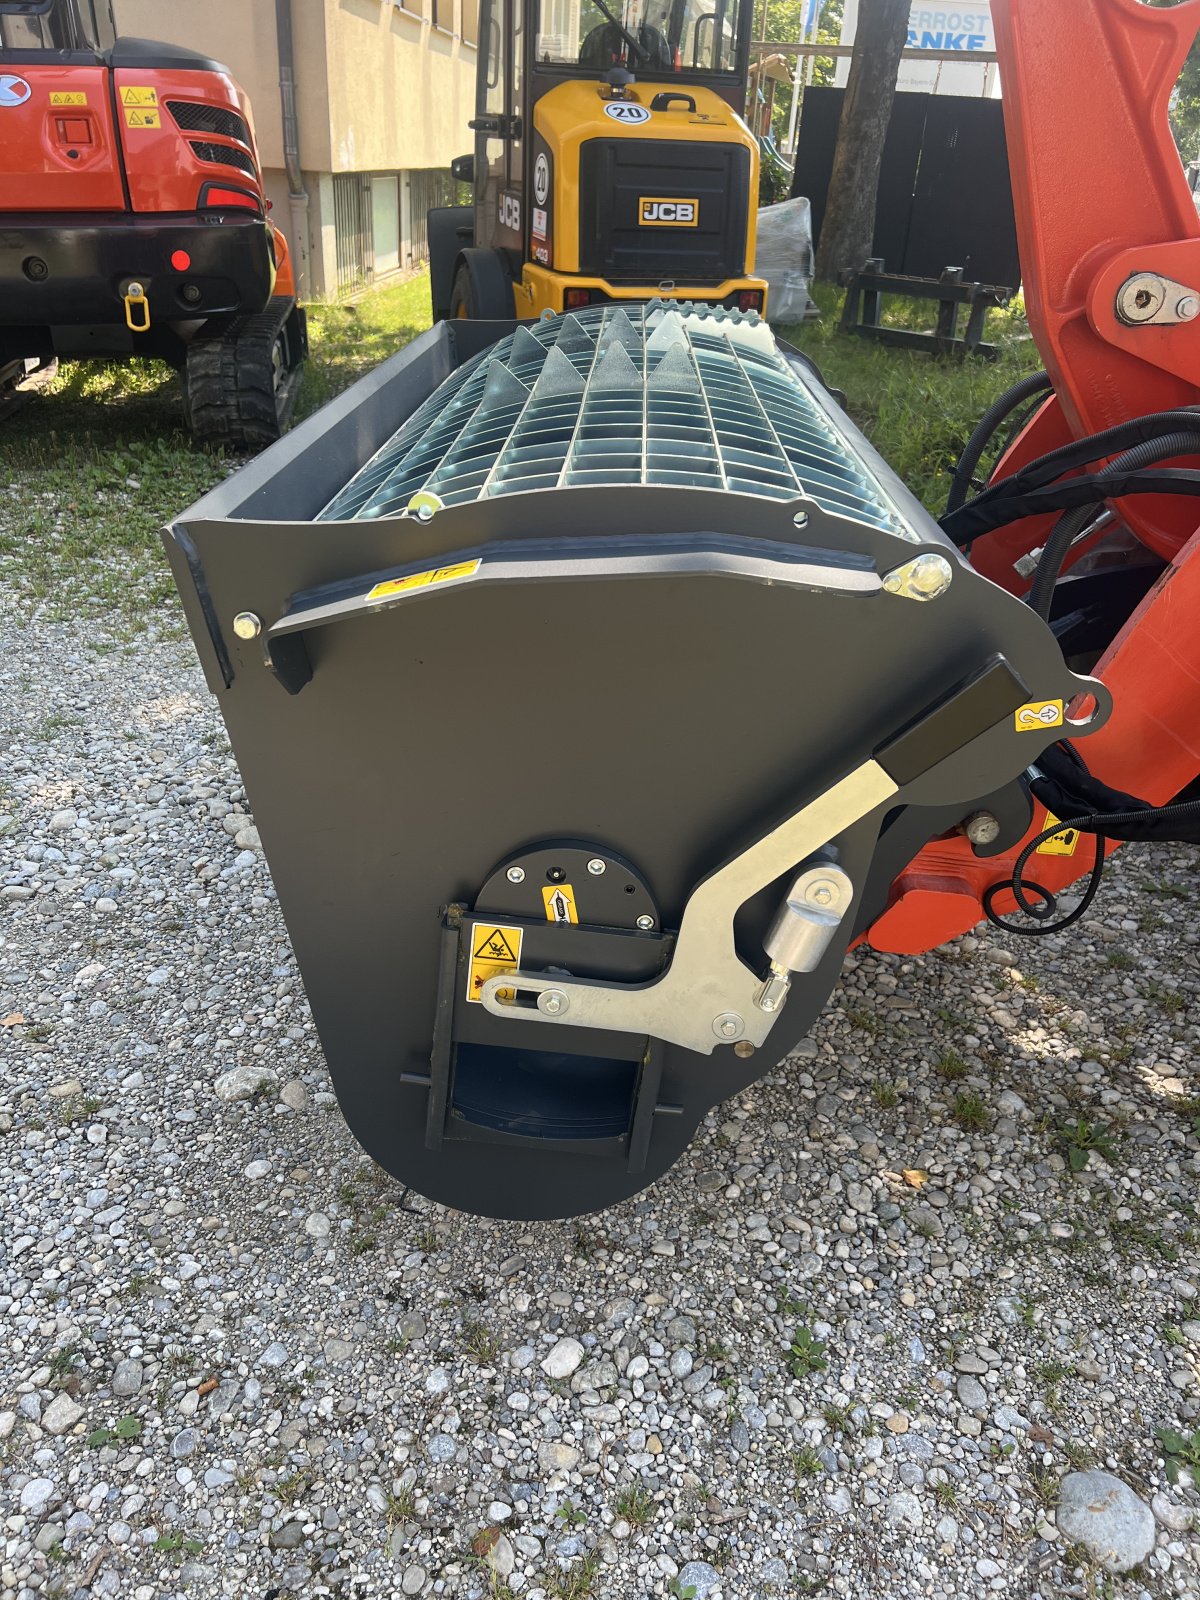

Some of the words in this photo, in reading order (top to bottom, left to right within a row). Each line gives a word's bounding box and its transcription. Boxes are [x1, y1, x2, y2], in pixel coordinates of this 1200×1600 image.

[612, 106, 643, 119] 20
[537, 166, 546, 193] 20
[499, 194, 520, 231] JCB
[643, 203, 694, 220] JCB
